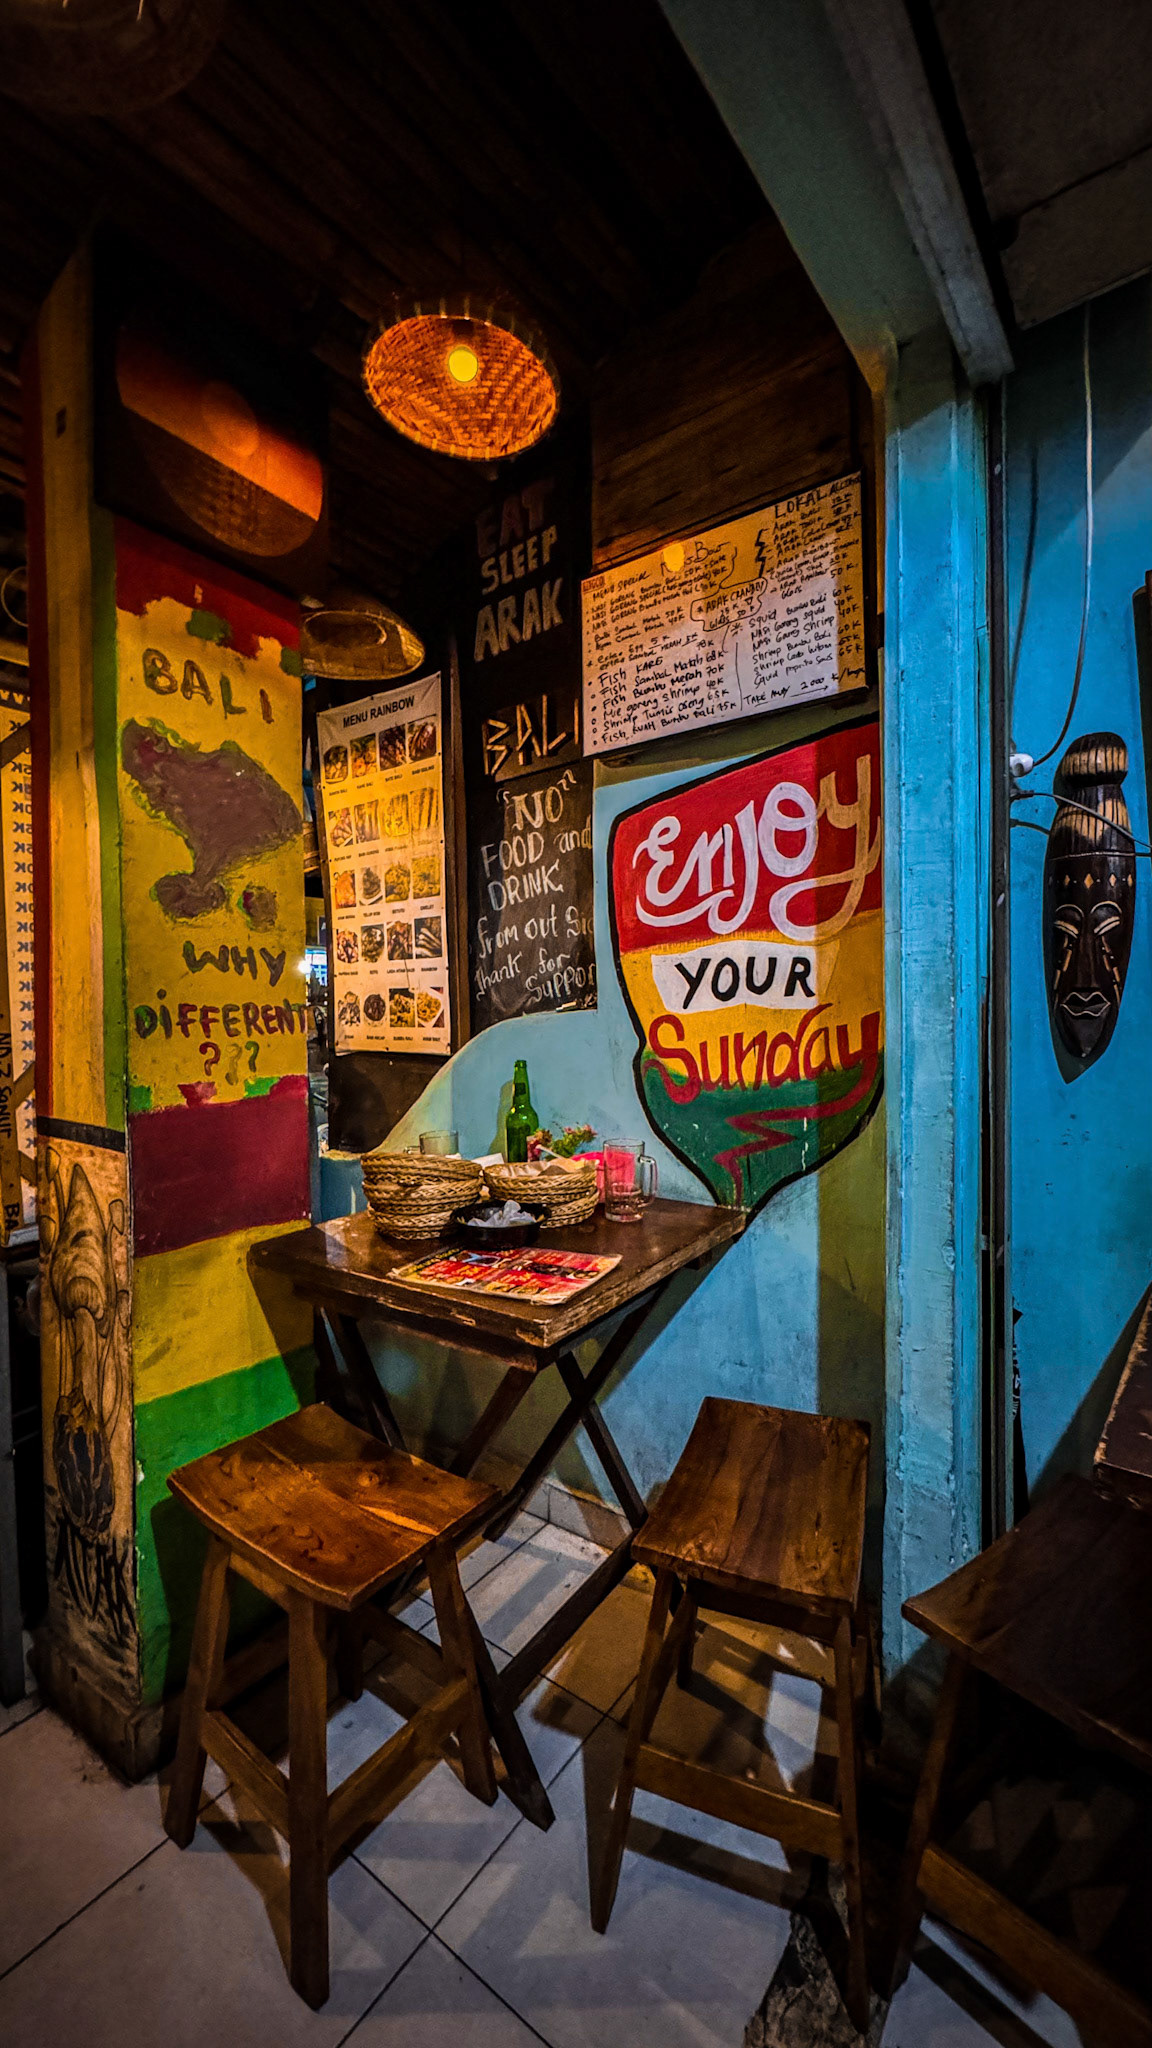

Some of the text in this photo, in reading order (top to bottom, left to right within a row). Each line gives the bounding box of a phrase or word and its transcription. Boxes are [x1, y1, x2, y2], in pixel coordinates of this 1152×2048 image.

[774, 489, 828, 519] LOKAL
[481, 524, 558, 596] SLEEP
[473, 576, 564, 663] ARAK
[140, 646, 276, 725] BALI
[342, 695, 415, 729] MENU RAINBOW
[482, 694, 579, 777] BALI
[480, 813, 593, 881] FOOD and
[486, 858, 565, 911] DRINK
[523, 903, 560, 941] out
[182, 939, 287, 988] WHY
[537, 946, 572, 976] for
[675, 954, 818, 1010] YOUR
[641, 1002, 883, 1106] Sunday
